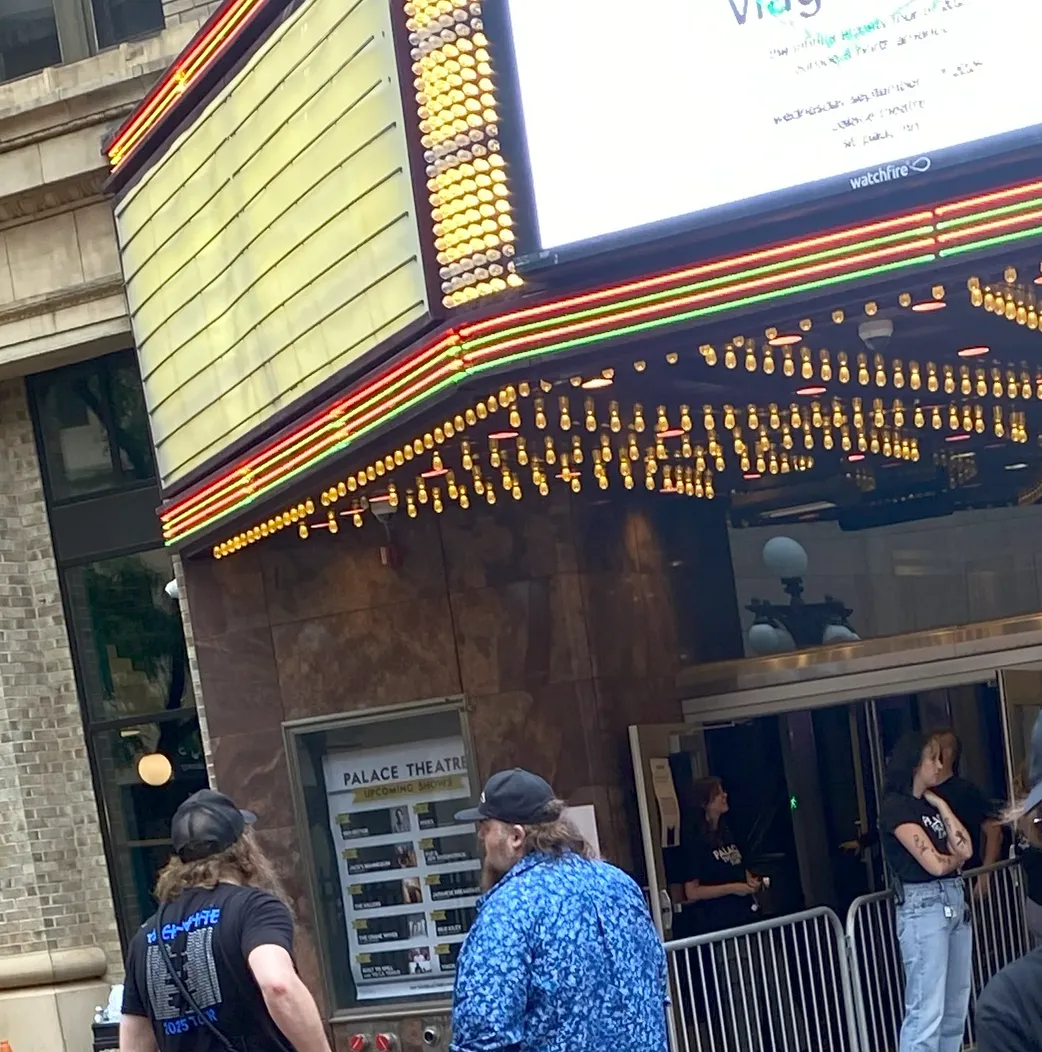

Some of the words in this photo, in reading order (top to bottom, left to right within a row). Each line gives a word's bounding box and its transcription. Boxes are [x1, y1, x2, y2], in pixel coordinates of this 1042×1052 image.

[850, 164, 909, 190] watchfire
[343, 765, 399, 786] PALACE
[364, 784, 413, 798] UPCOMING
[419, 779, 453, 791] SHOWS
